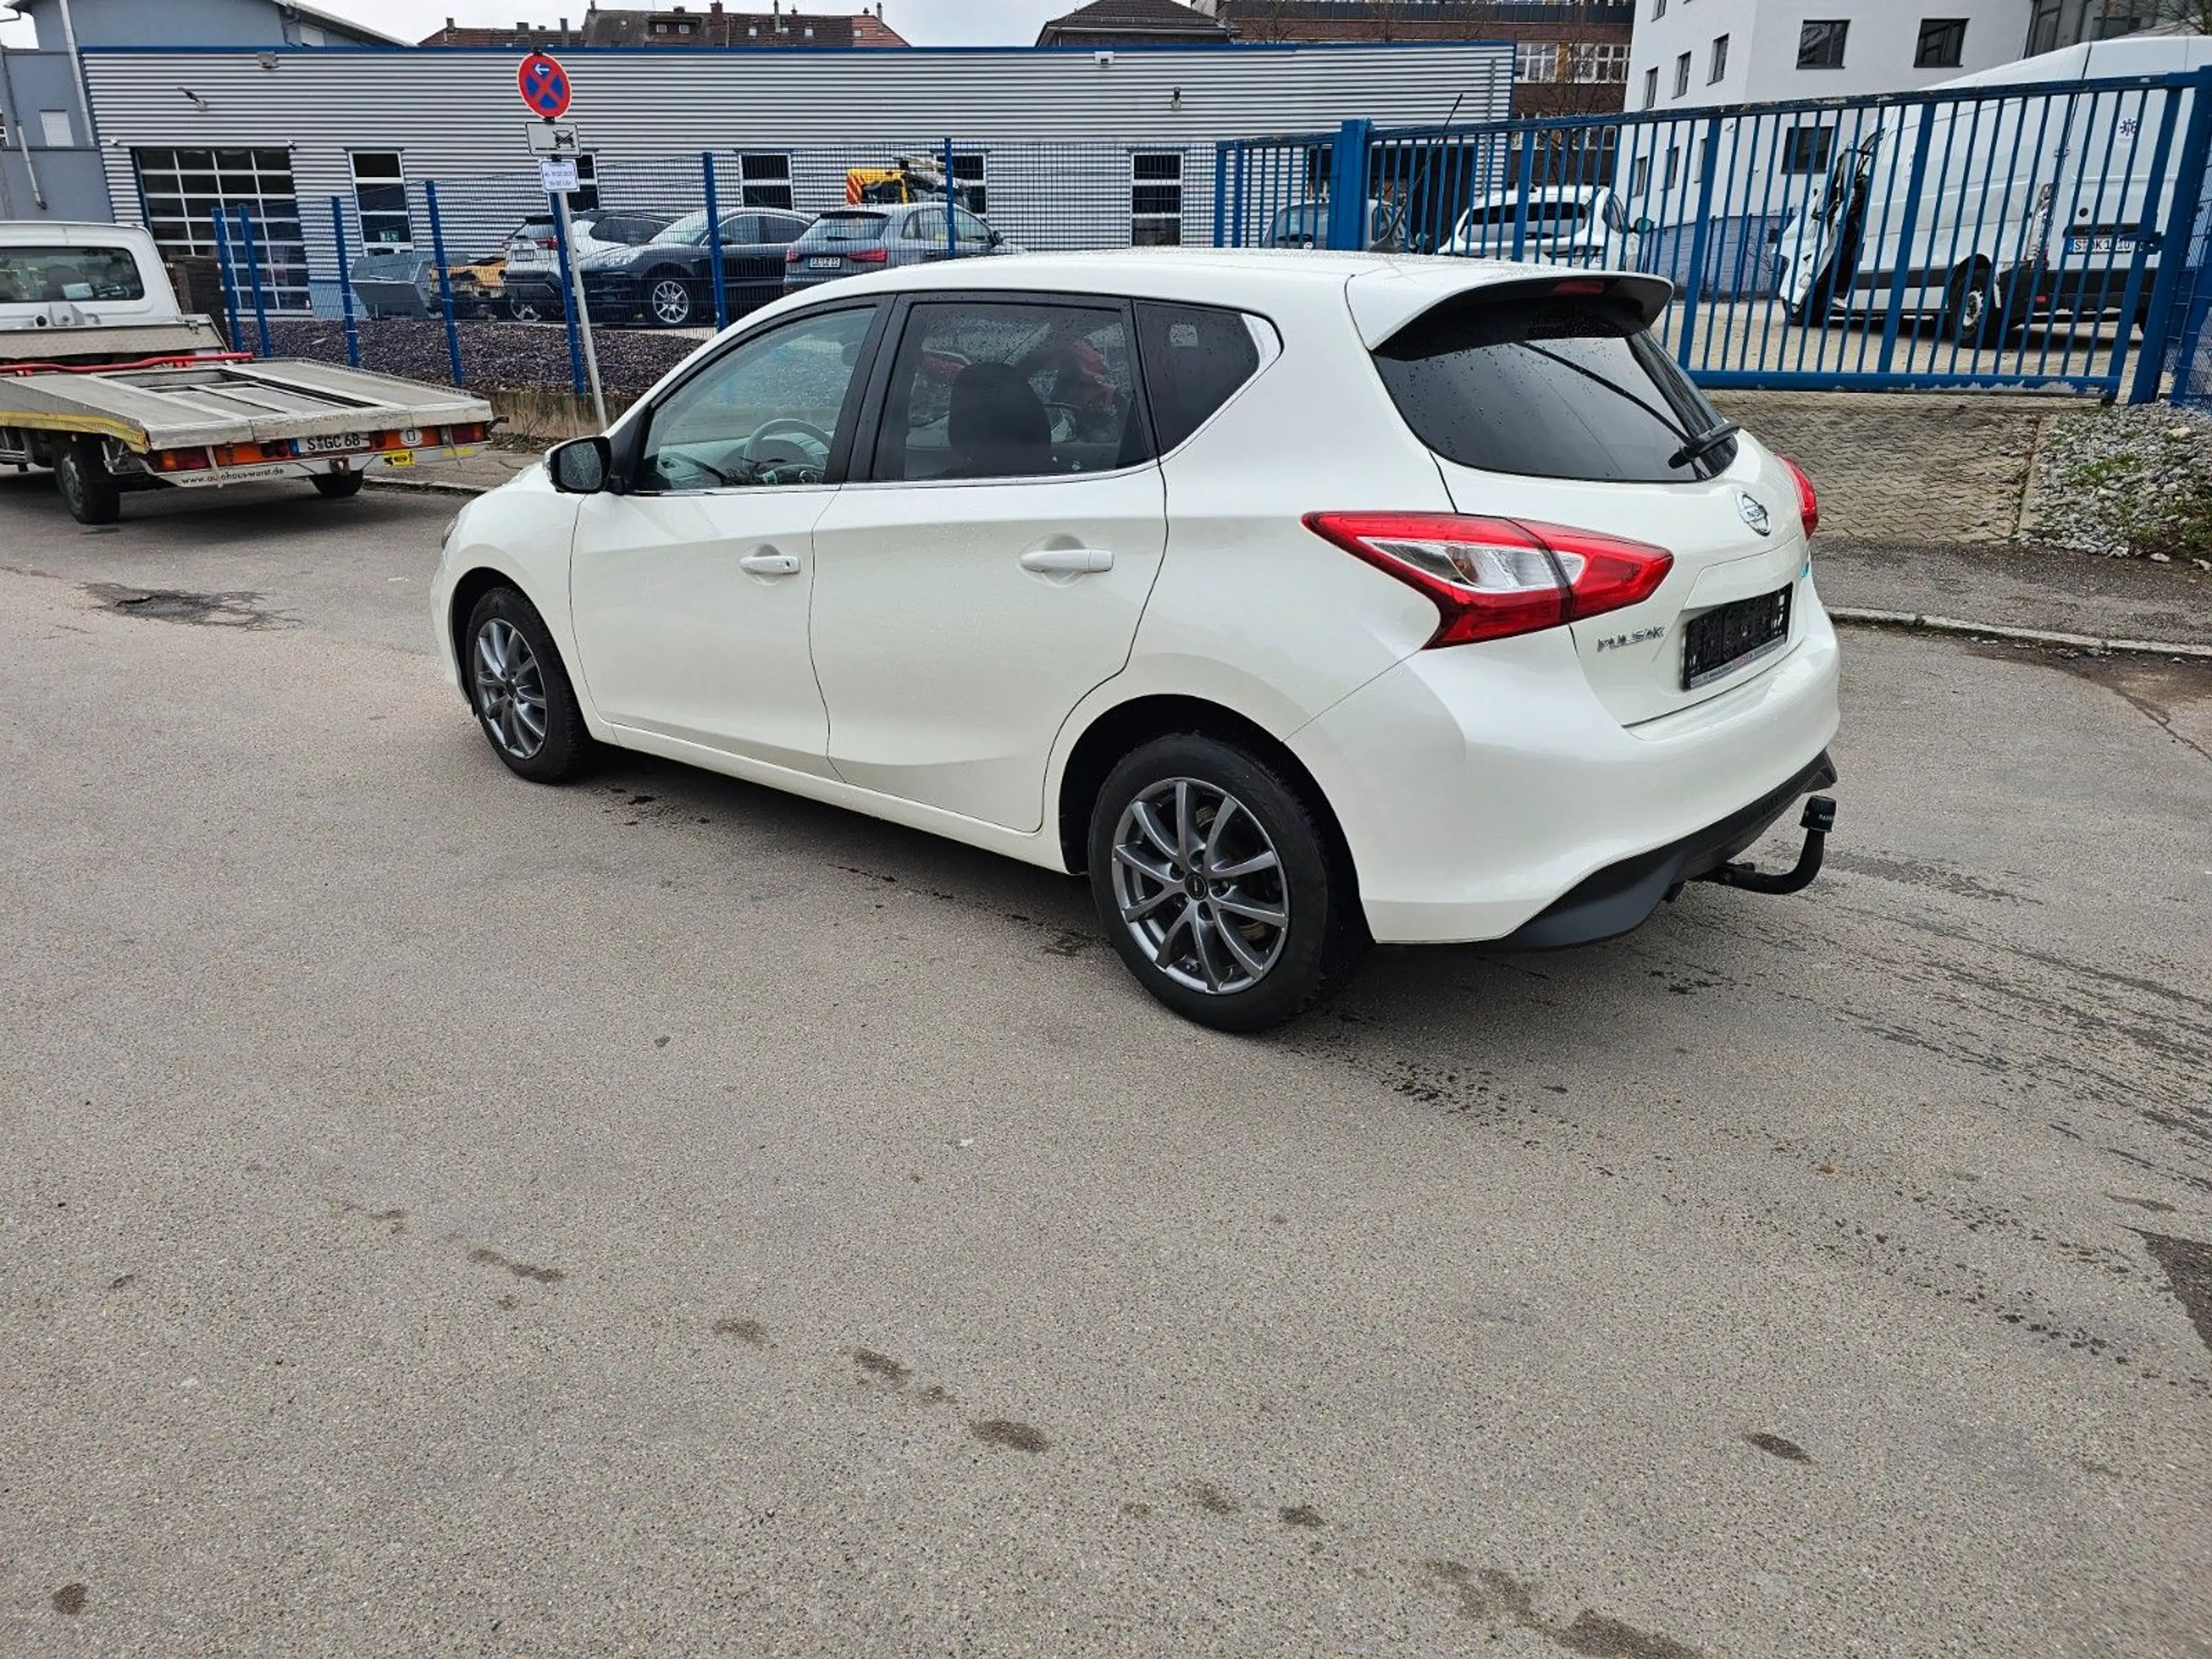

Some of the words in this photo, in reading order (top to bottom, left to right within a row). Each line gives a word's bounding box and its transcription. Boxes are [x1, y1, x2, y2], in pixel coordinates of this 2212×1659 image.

[307, 437, 316, 450] S
[324, 435, 342, 448] GC
[345, 433, 360, 446] 68
